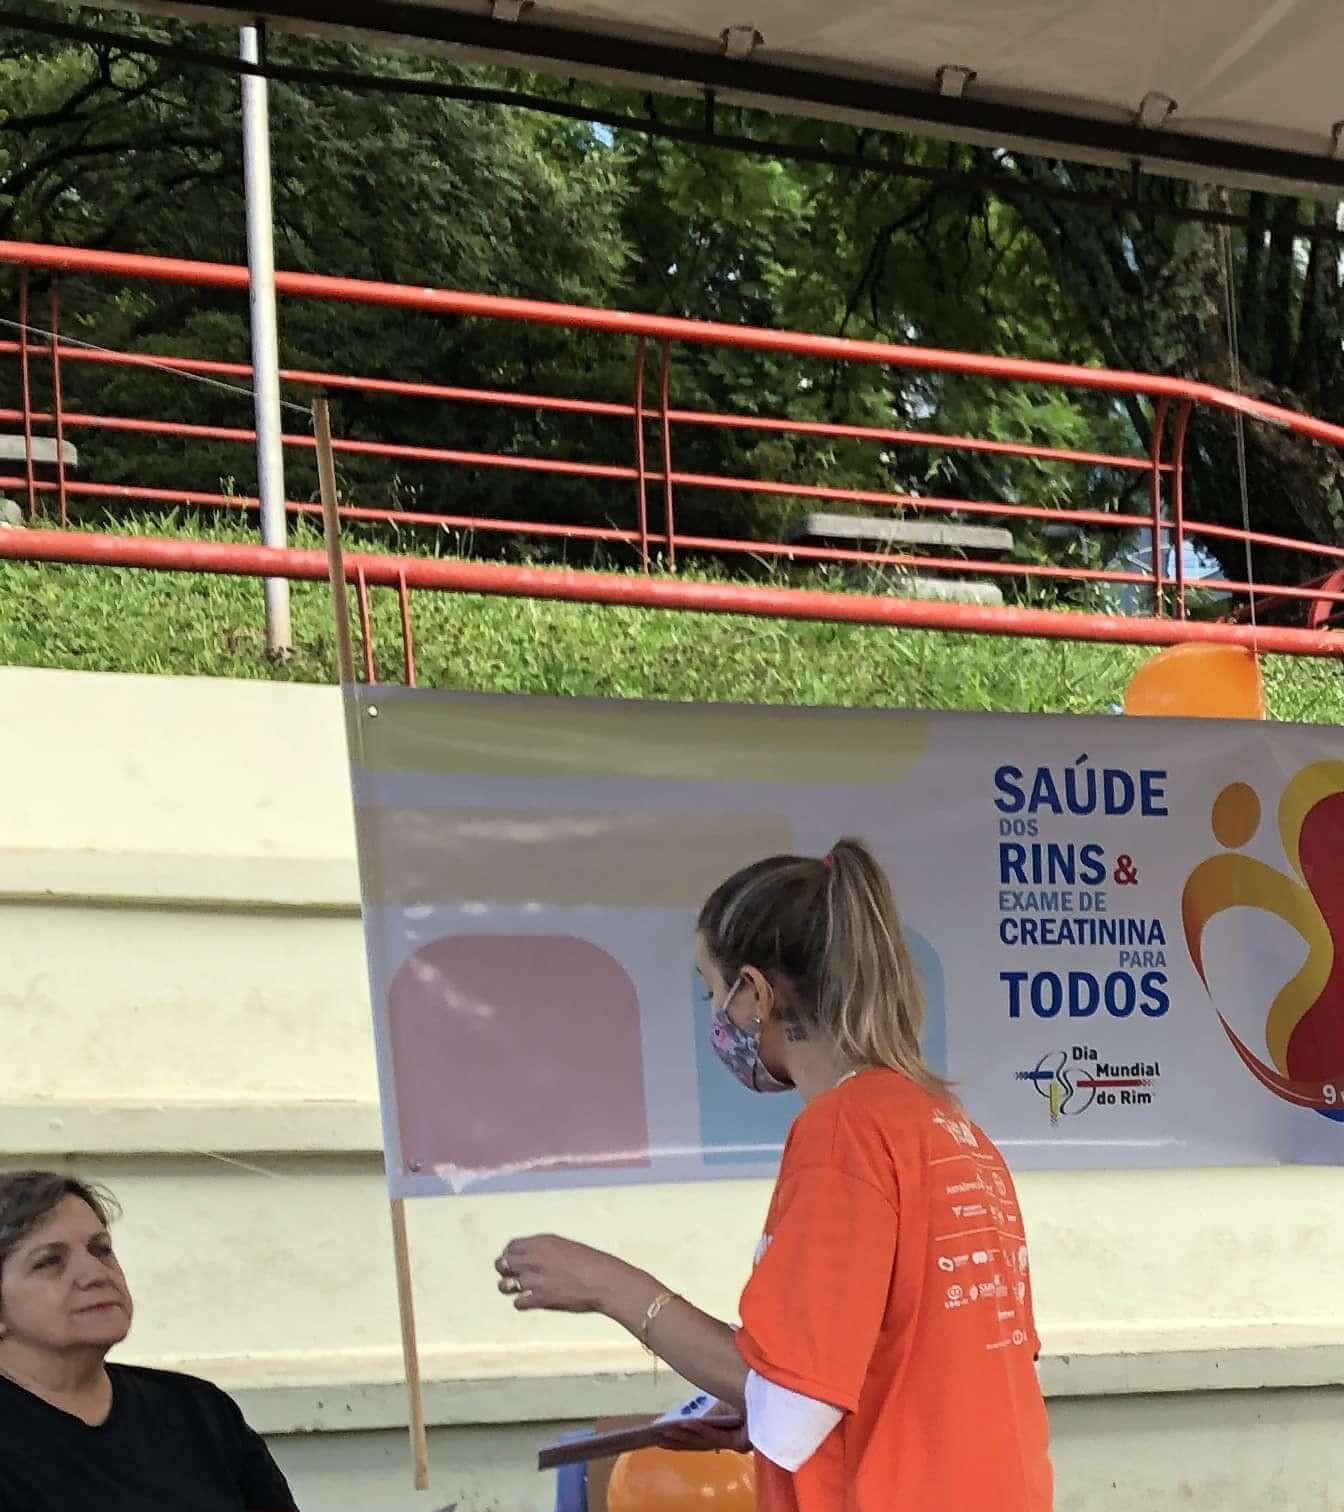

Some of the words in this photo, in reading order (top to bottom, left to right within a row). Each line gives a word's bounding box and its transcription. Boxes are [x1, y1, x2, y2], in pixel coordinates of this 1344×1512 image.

[994, 753, 1169, 817] SAÚDE
[999, 818, 1039, 836] DOS
[999, 842, 1107, 886] RINS
[1113, 854, 1138, 886] &
[999, 890, 1074, 912] EXAME
[1079, 891, 1107, 912] DE
[999, 918, 1167, 946] CREATININA
[1119, 950, 1167, 968] PARA
[999, 970, 1170, 1018] TODOS
[1072, 1045, 1098, 1061] Dia
[1096, 1062, 1160, 1078] Mundial
[1096, 1090, 1116, 1105] do
[1121, 1090, 1152, 1105] Rim
[1322, 1084, 1337, 1105] 9
